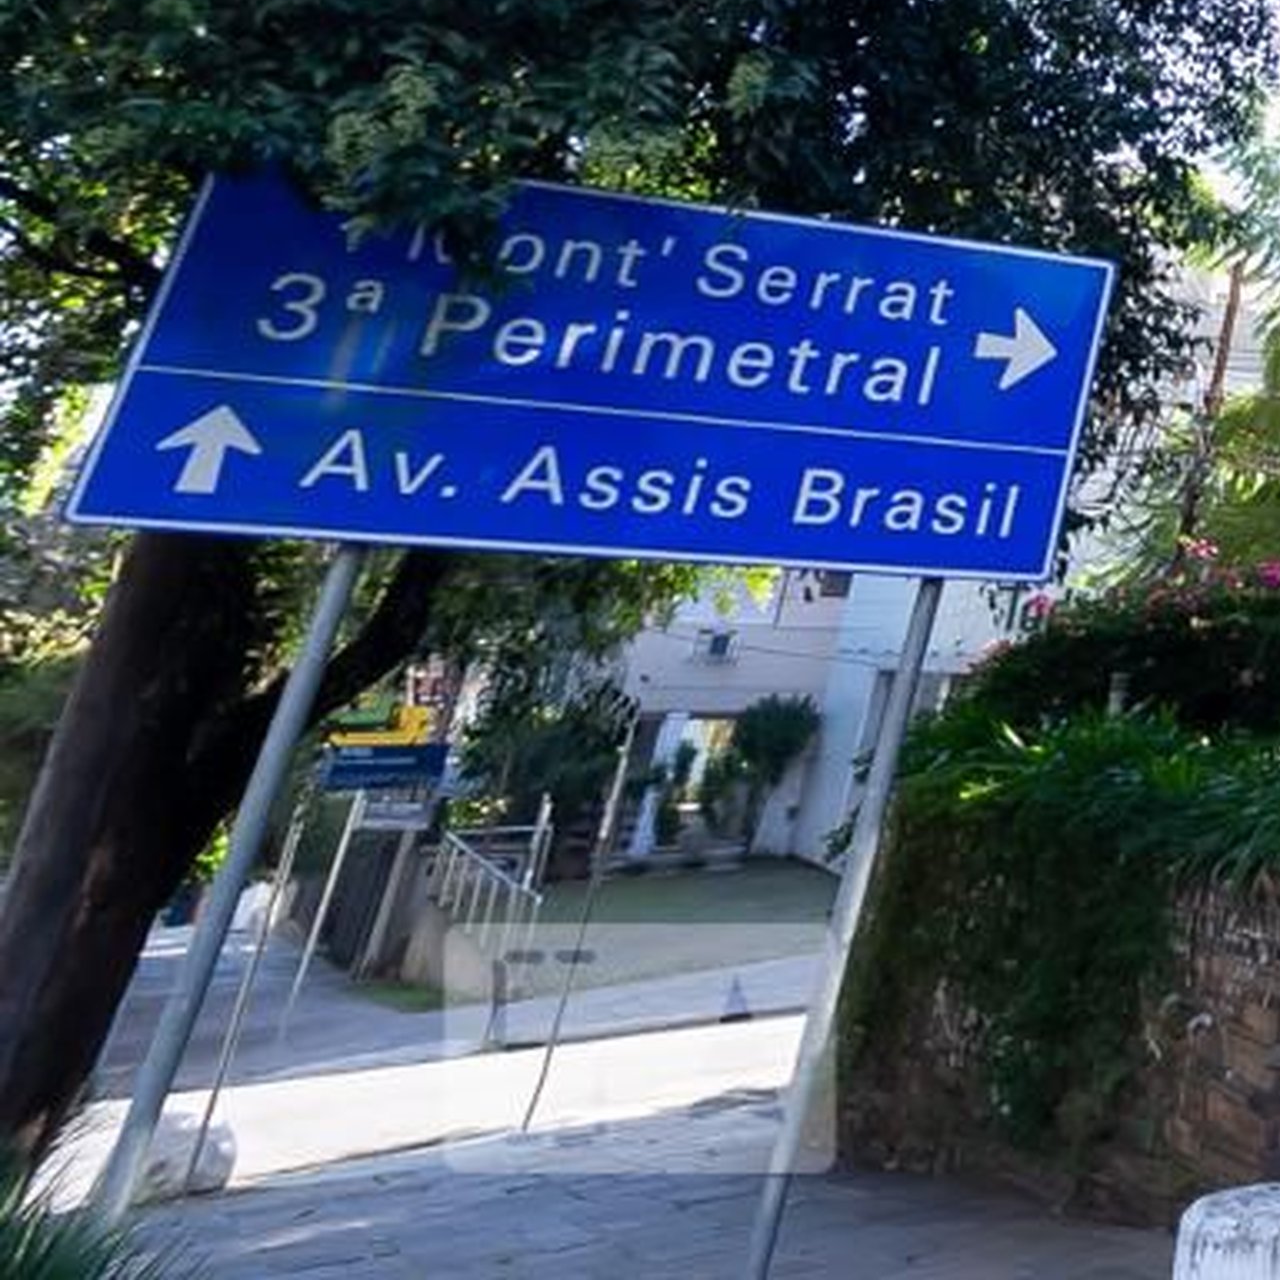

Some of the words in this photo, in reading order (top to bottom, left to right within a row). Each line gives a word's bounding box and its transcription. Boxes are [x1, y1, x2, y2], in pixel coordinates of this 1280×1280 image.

[697, 244, 955, 325] Serrat
[419, 294, 939, 405] Perimetral
[300, 429, 457, 500] Av.
[501, 446, 751, 518] Assis
[793, 468, 1019, 537] Brasil
